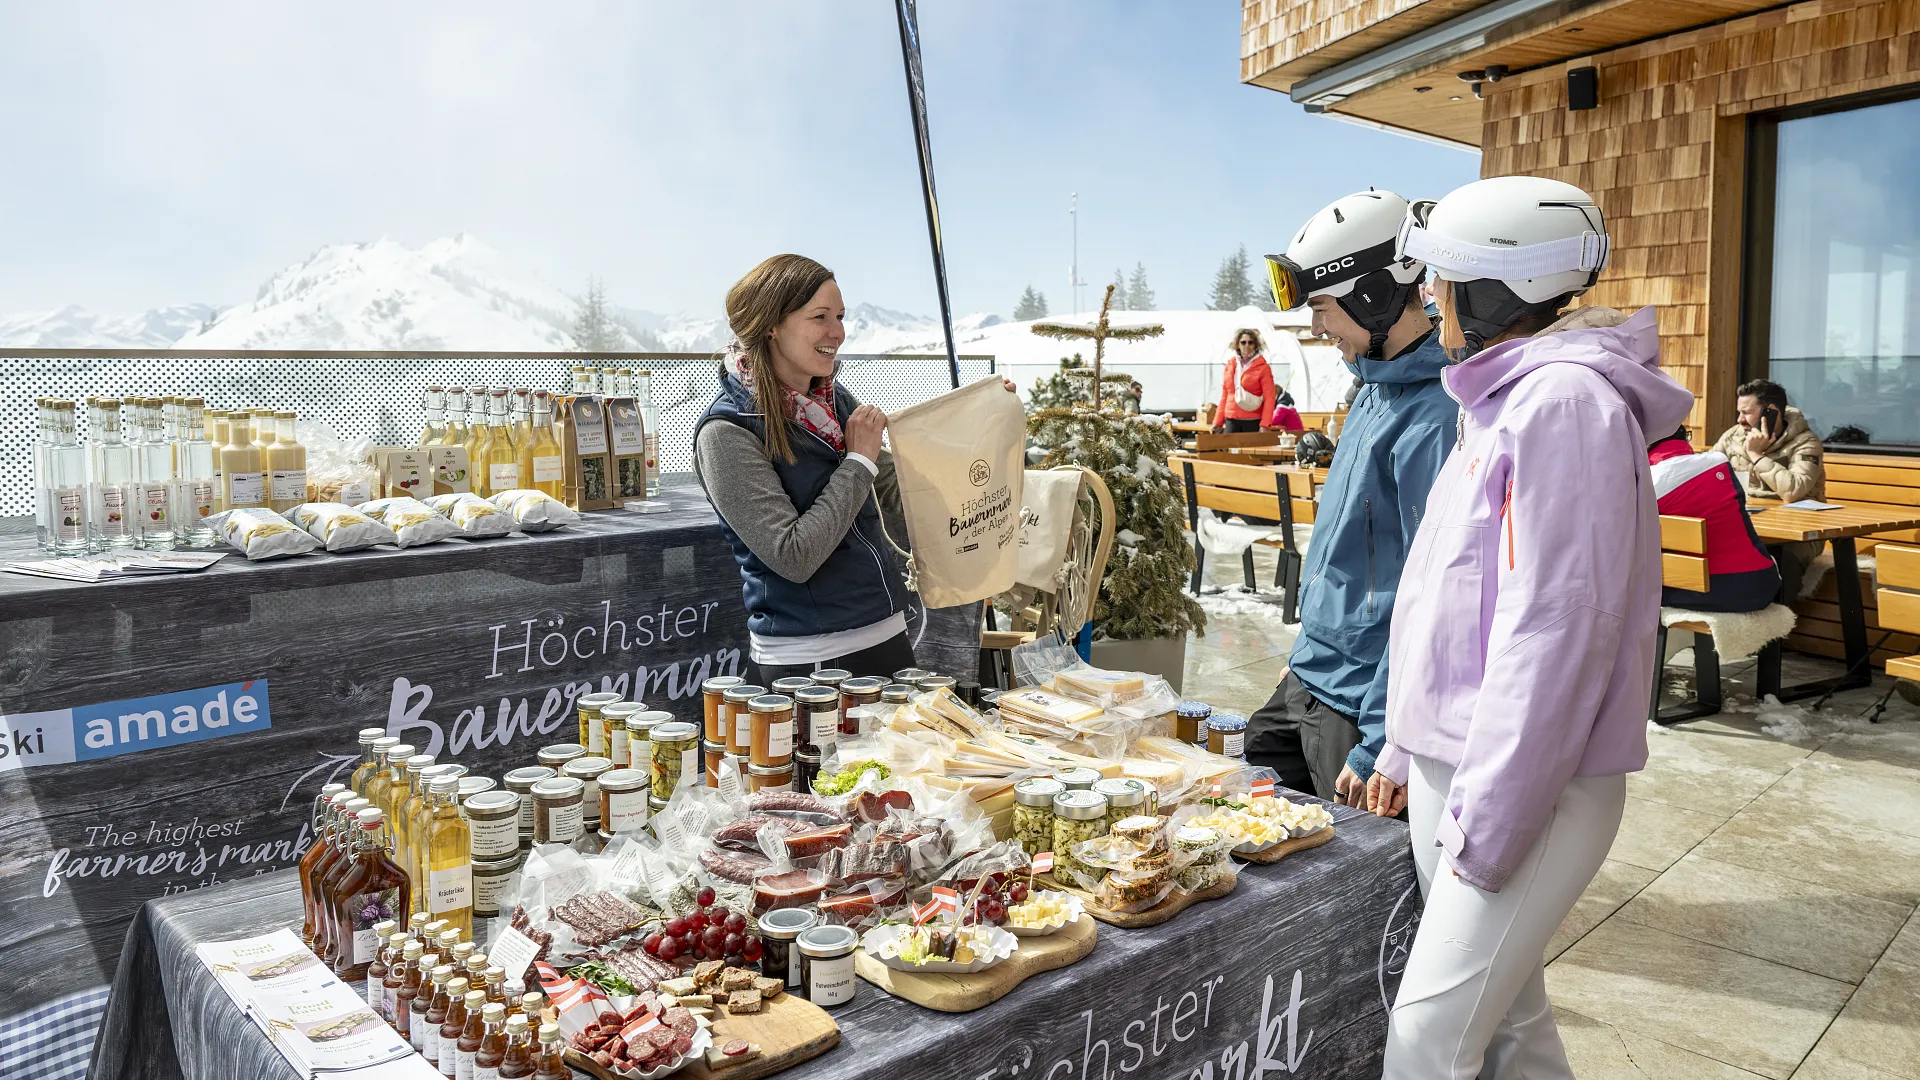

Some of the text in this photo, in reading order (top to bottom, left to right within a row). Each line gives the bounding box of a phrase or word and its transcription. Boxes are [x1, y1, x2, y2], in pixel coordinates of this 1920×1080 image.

[1430, 246, 1479, 265] ATOMIC
[1490, 237, 1518, 246] ATOMIC
[961, 485, 1008, 517] Höchster
[971, 526, 986, 538] der
[485, 600, 719, 680] Höchster
[0, 681, 259, 760] Ski amadé
[85, 817, 244, 848] The highest
[43, 840, 216, 898] farmer's
[438, 886, 465, 898] Kräuterlikör
